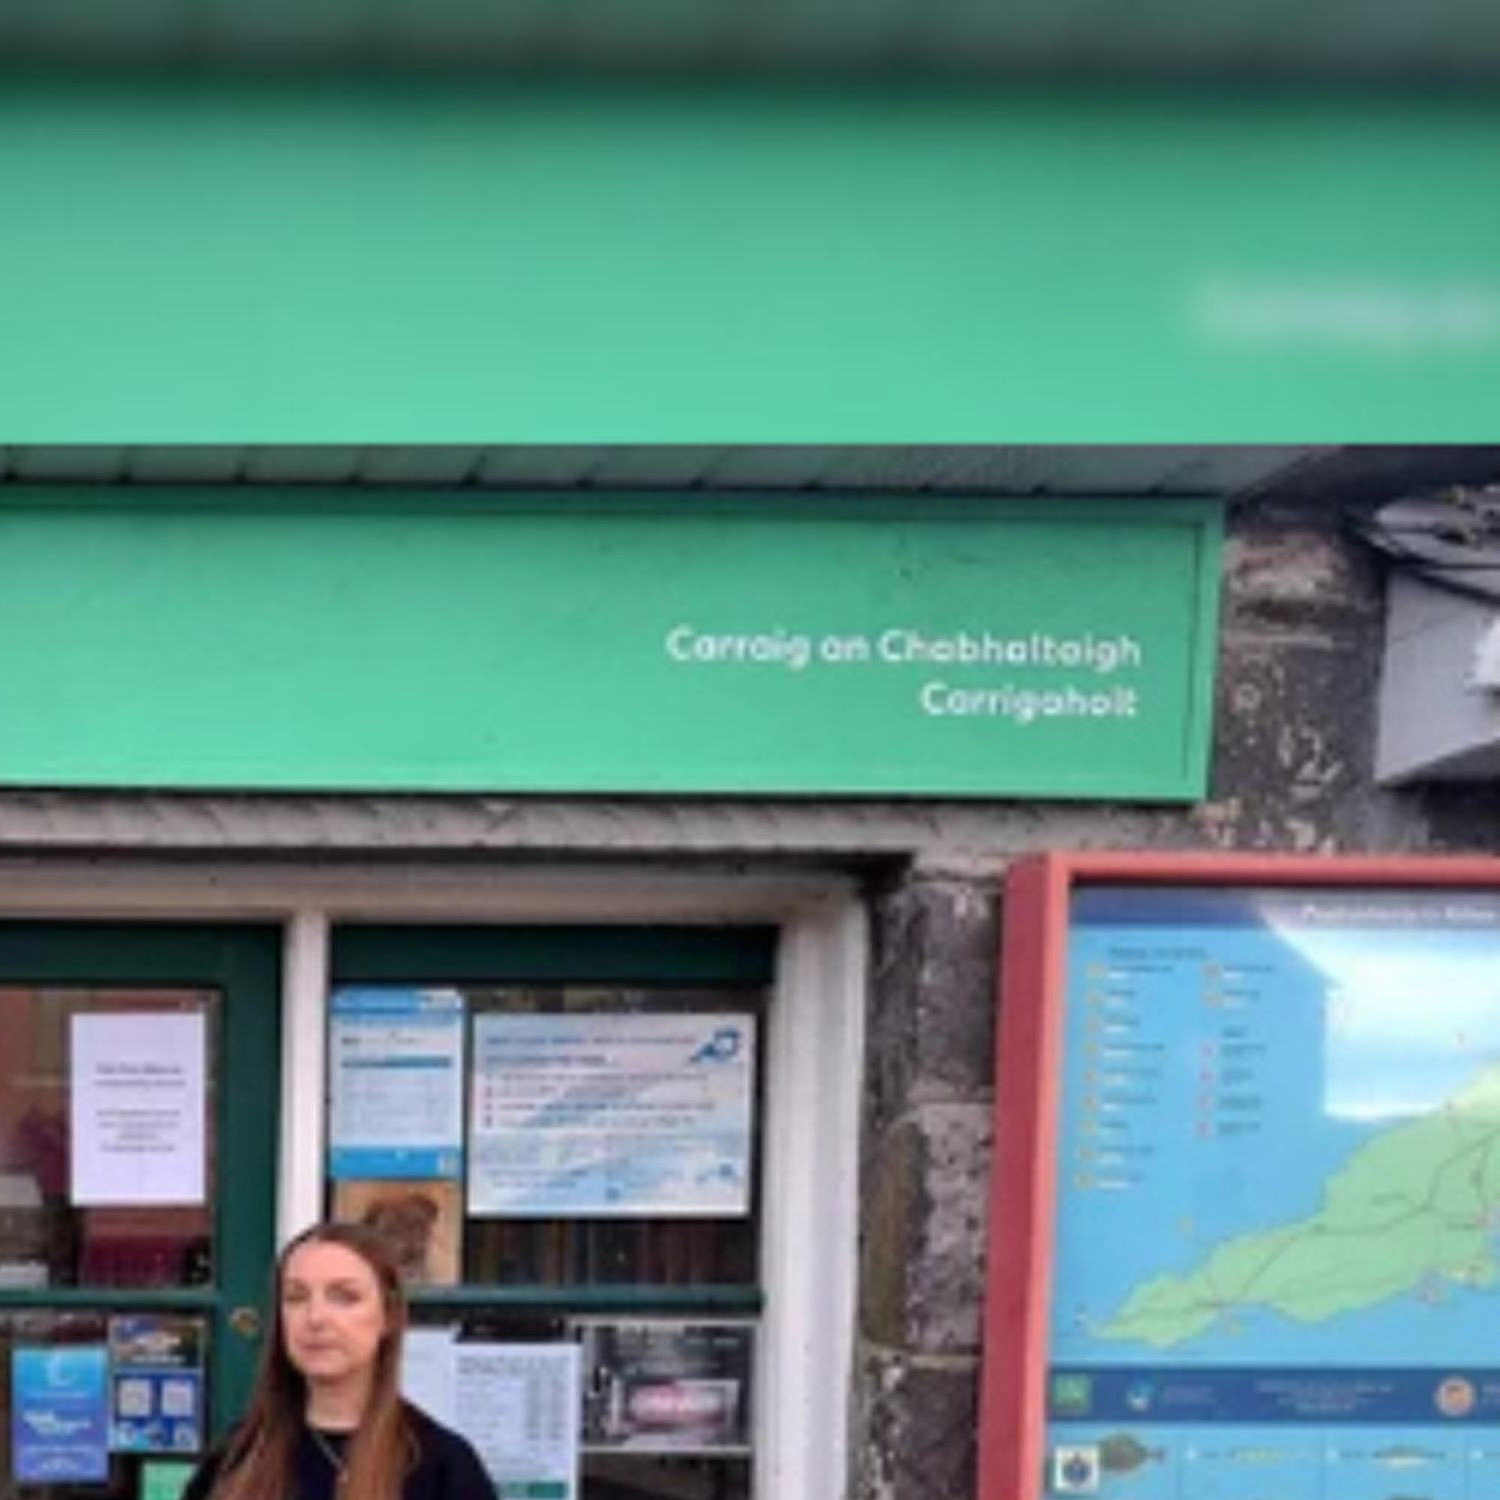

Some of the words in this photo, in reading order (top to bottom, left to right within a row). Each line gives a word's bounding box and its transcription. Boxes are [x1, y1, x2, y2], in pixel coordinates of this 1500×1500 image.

[665, 627, 809, 668] Carraig
[819, 636, 869, 661] an
[879, 629, 1140, 671] Chabhaltaigh
[920, 681, 1138, 722] Carrigaholt
